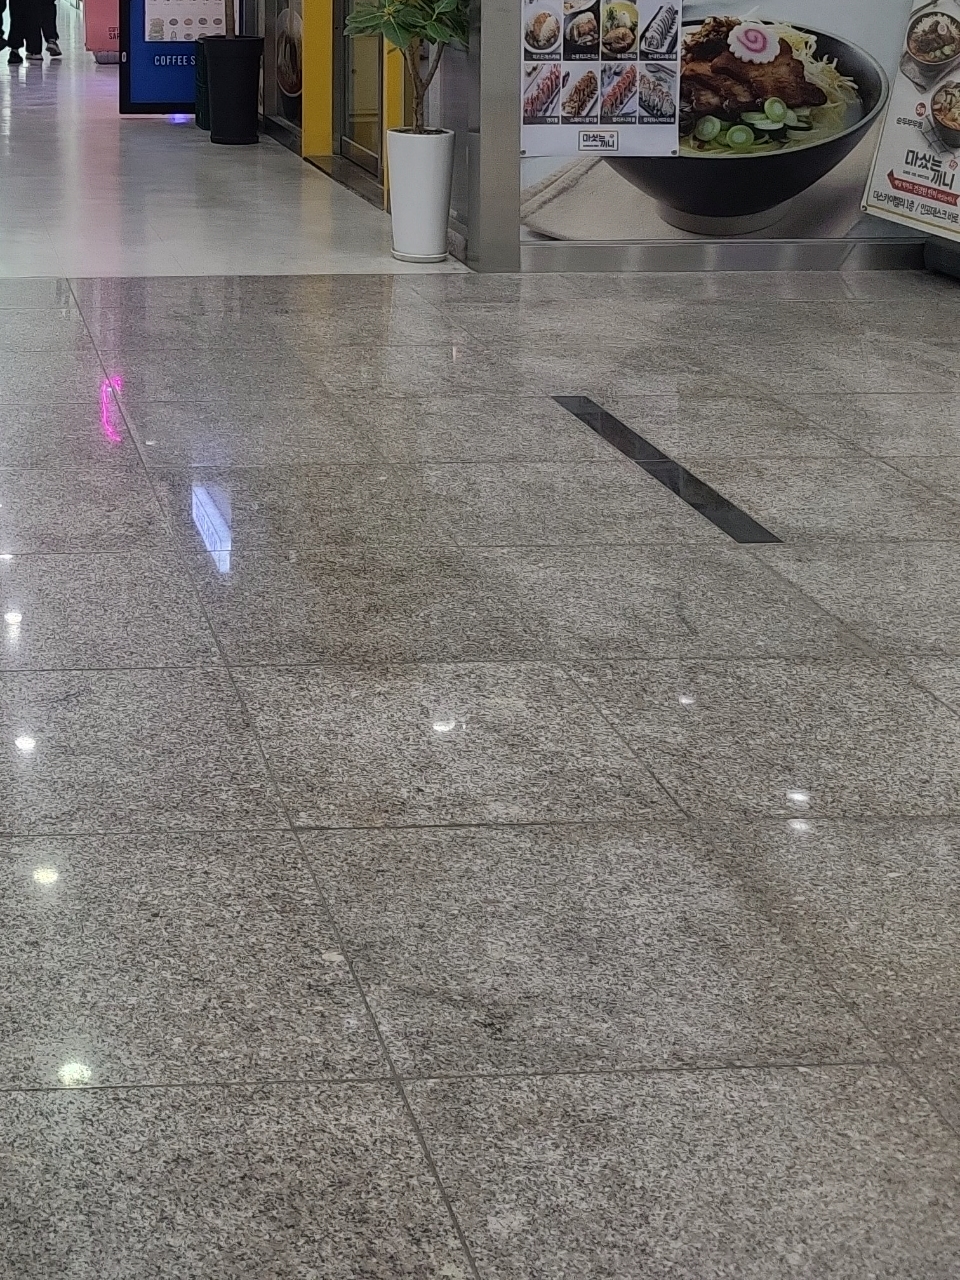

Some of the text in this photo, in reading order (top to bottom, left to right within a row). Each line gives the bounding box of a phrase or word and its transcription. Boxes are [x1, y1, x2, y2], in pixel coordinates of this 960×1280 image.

[154, 55, 188, 66] COFFEE
[930, 171, 955, 191] 끼니
[873, 190, 905, 209] 더스카이밸리
[906, 197, 915, 212] 1층
